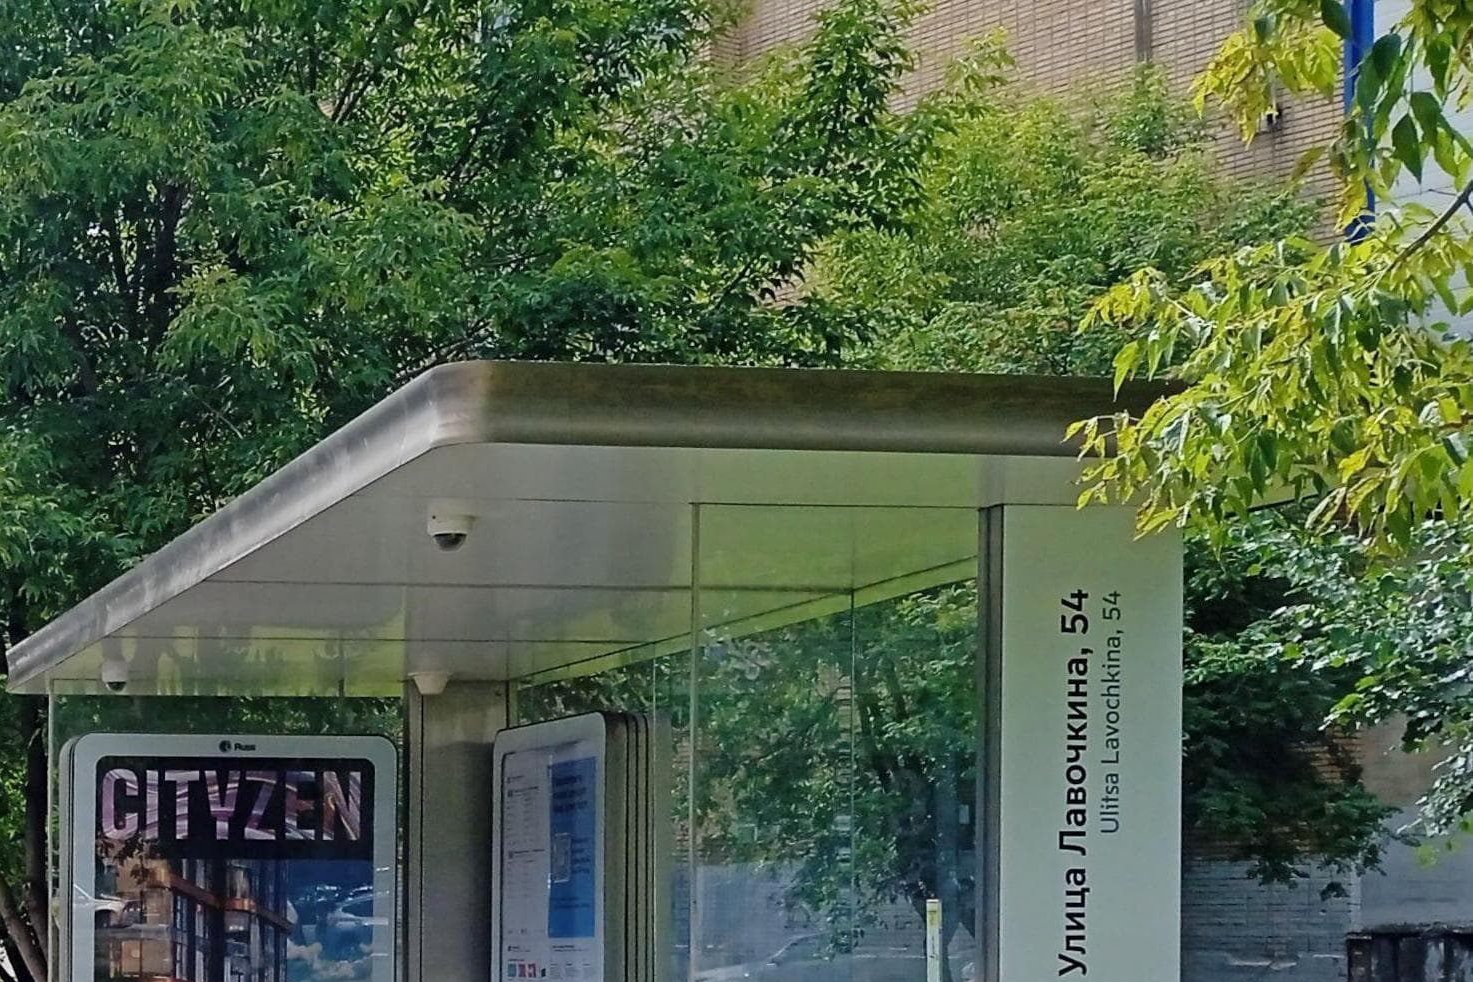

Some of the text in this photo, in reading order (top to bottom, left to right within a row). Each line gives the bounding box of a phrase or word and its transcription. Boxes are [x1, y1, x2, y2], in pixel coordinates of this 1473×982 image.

[101, 768, 362, 841] CITYZEN
[1058, 588, 1093, 977] Улица Лавочкина, 54
[1100, 590, 1125, 834] Ulitsa Lavochkina, 54
